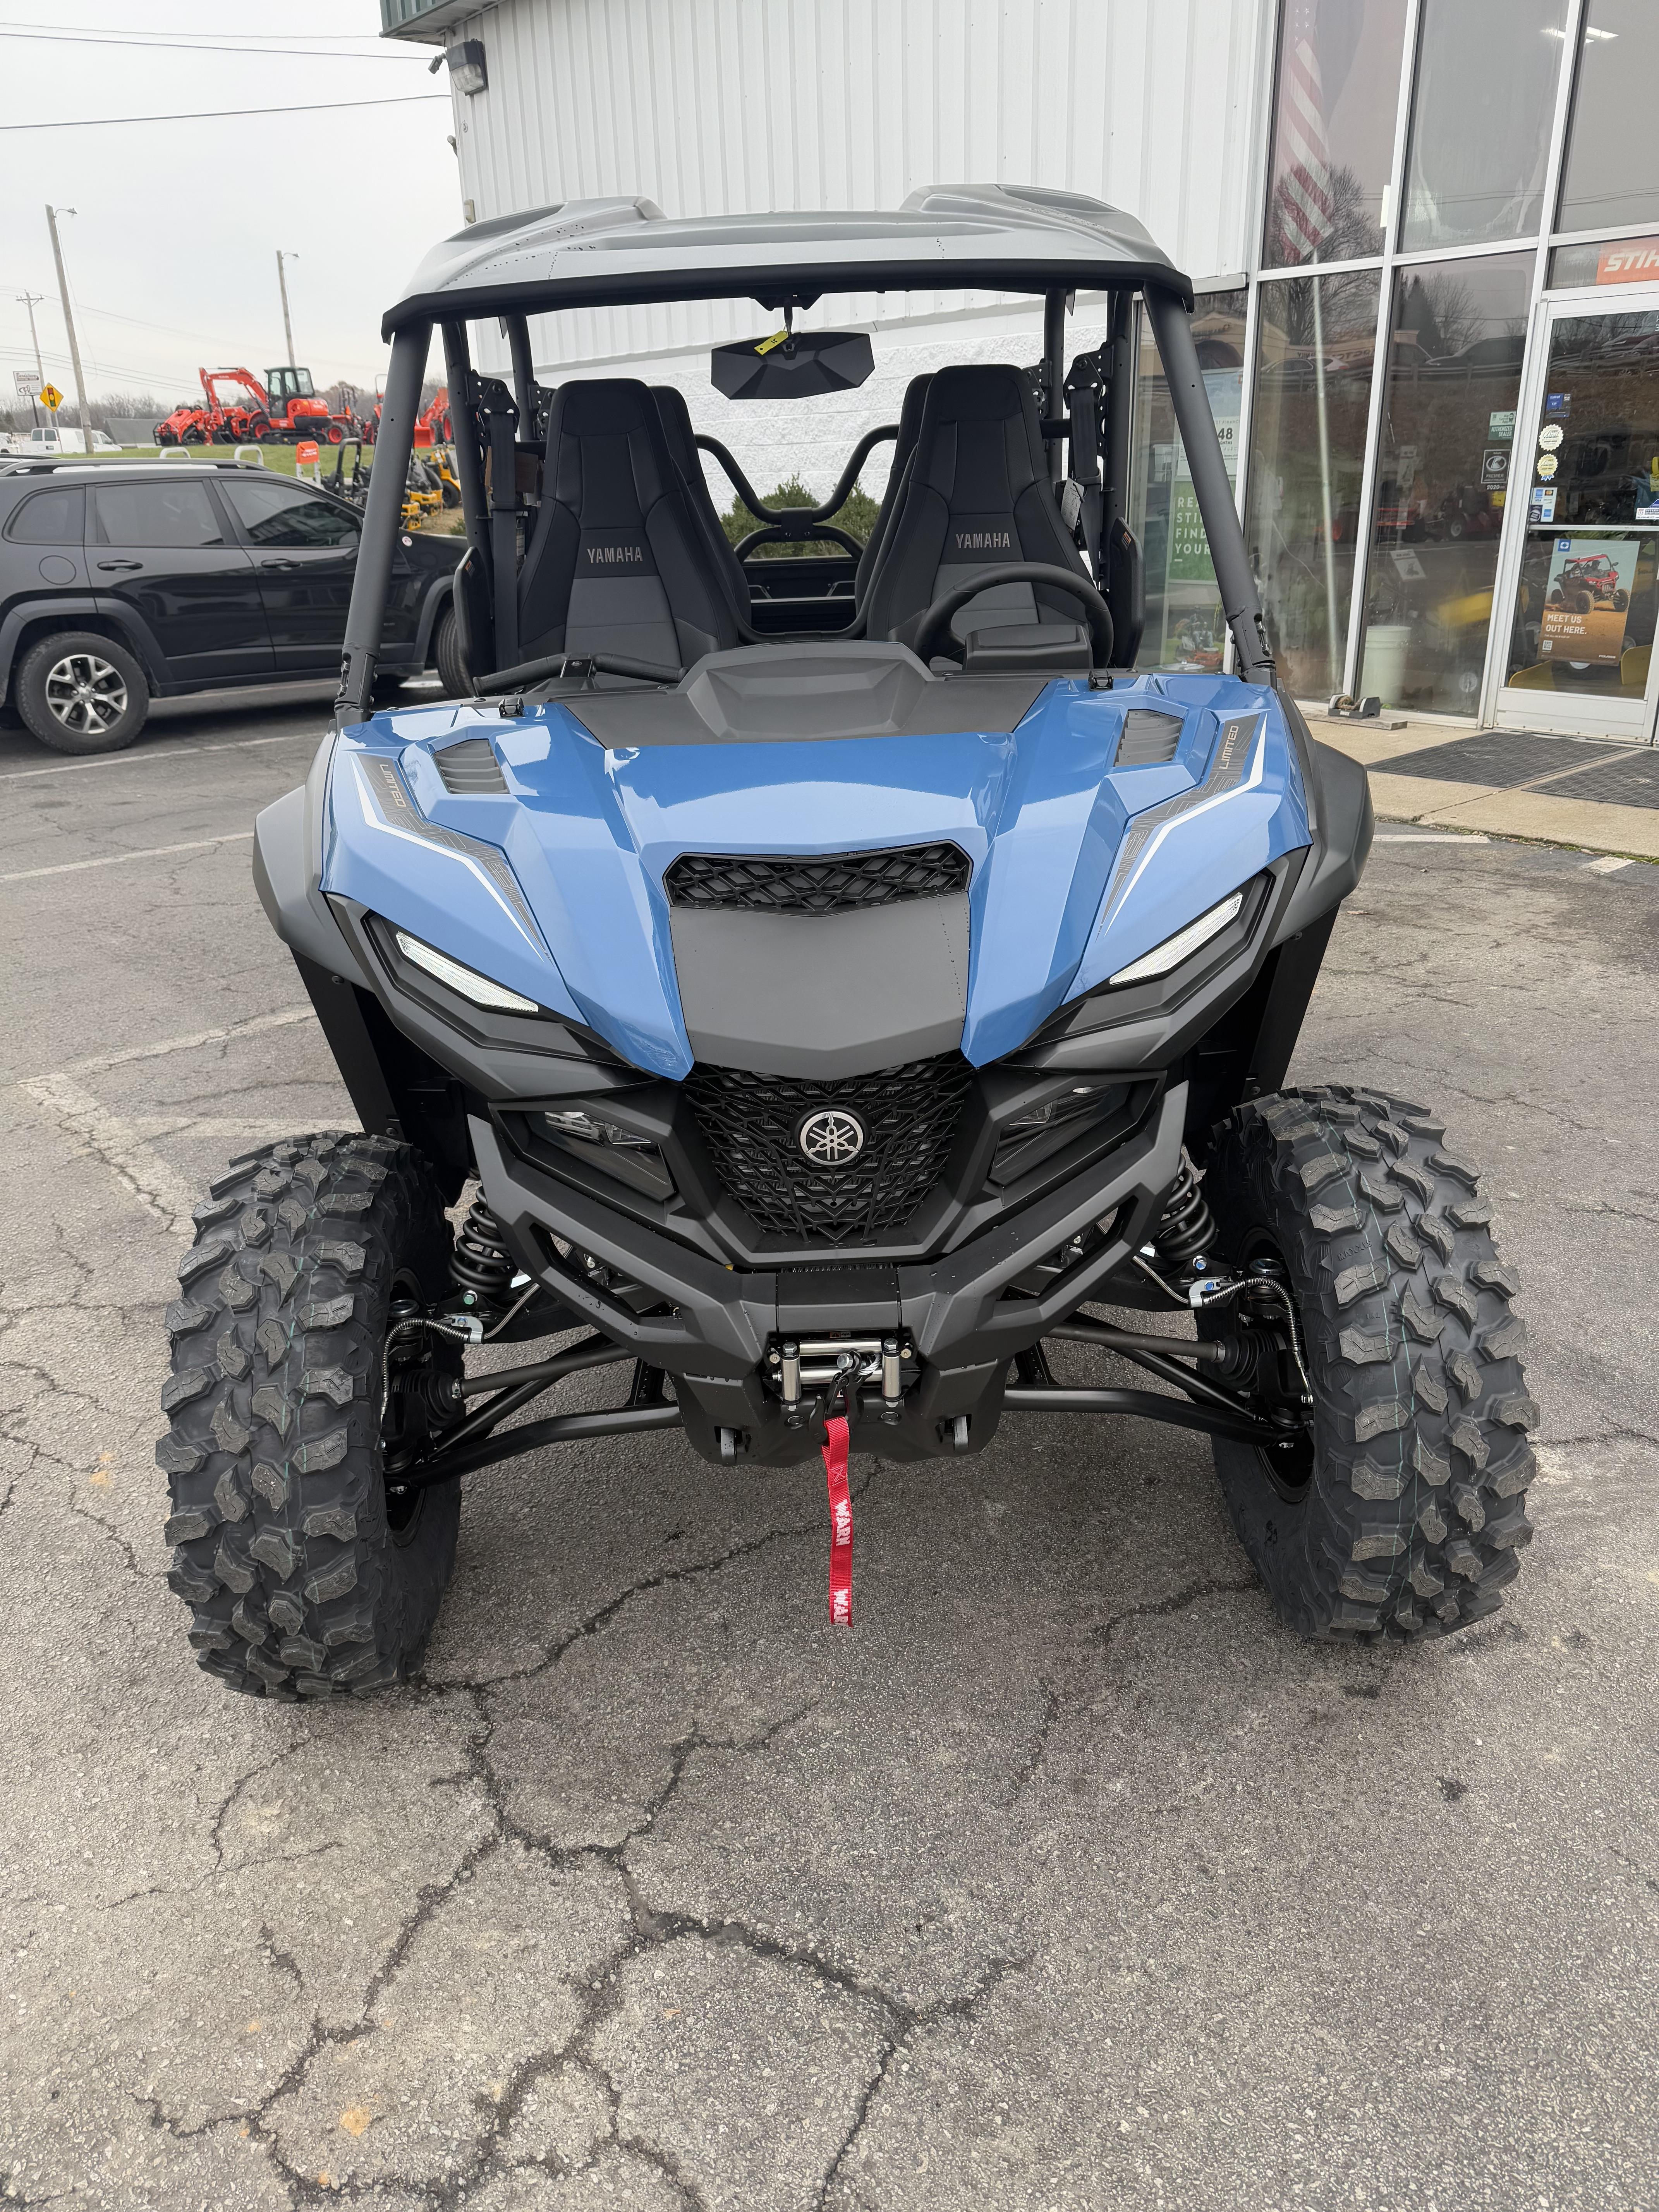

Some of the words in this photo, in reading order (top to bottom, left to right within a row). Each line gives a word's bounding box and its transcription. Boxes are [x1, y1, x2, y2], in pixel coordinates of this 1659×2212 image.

[1218, 428, 1233, 440] 48
[955, 532, 1010, 548] YAMAHA
[1176, 528, 1207, 539] FIND
[587, 547, 643, 563] YAMAHA
[1175, 543, 1211, 555] YOUR
[1546, 624, 1562, 632] OUT
[1563, 625, 1587, 634] HERE.
[1219, 725, 1239, 769] LIMITED
[380, 764, 406, 807] LIMITED
[1337, 1240, 1372, 1261] MAXXIS
[835, 1498, 851, 1546] WARN
[833, 1589, 848, 1625] WAR
